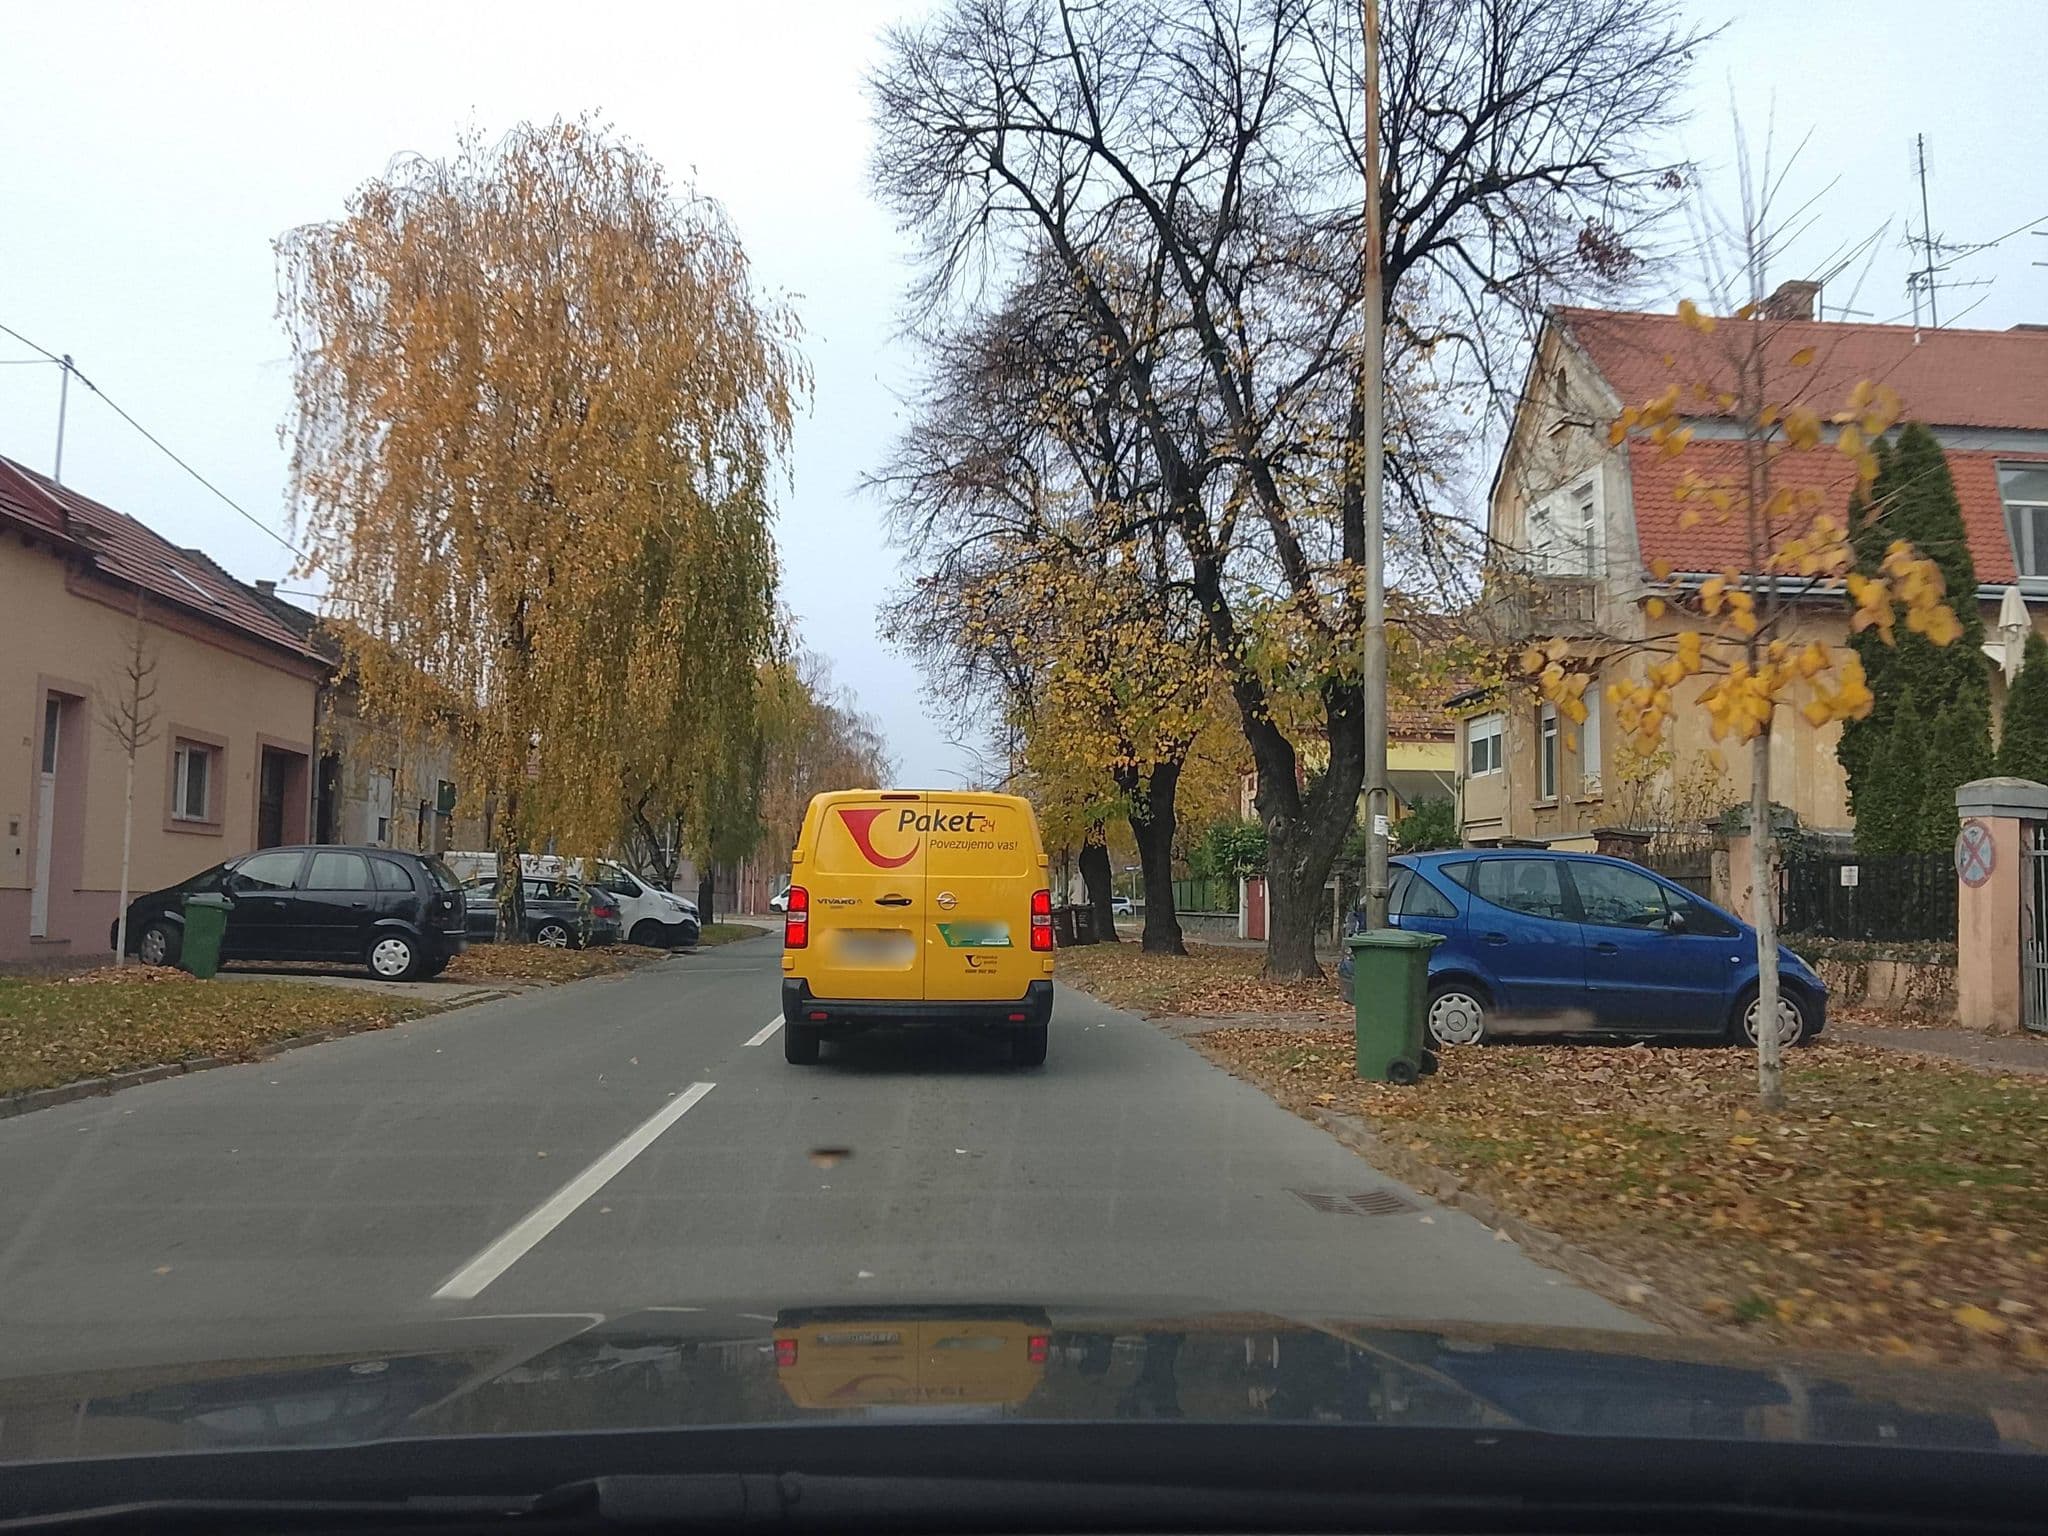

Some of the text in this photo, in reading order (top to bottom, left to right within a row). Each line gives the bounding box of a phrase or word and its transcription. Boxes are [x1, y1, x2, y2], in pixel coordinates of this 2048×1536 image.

[898, 809, 996, 832] Paket 24
[930, 839, 994, 851] Povezujemo
